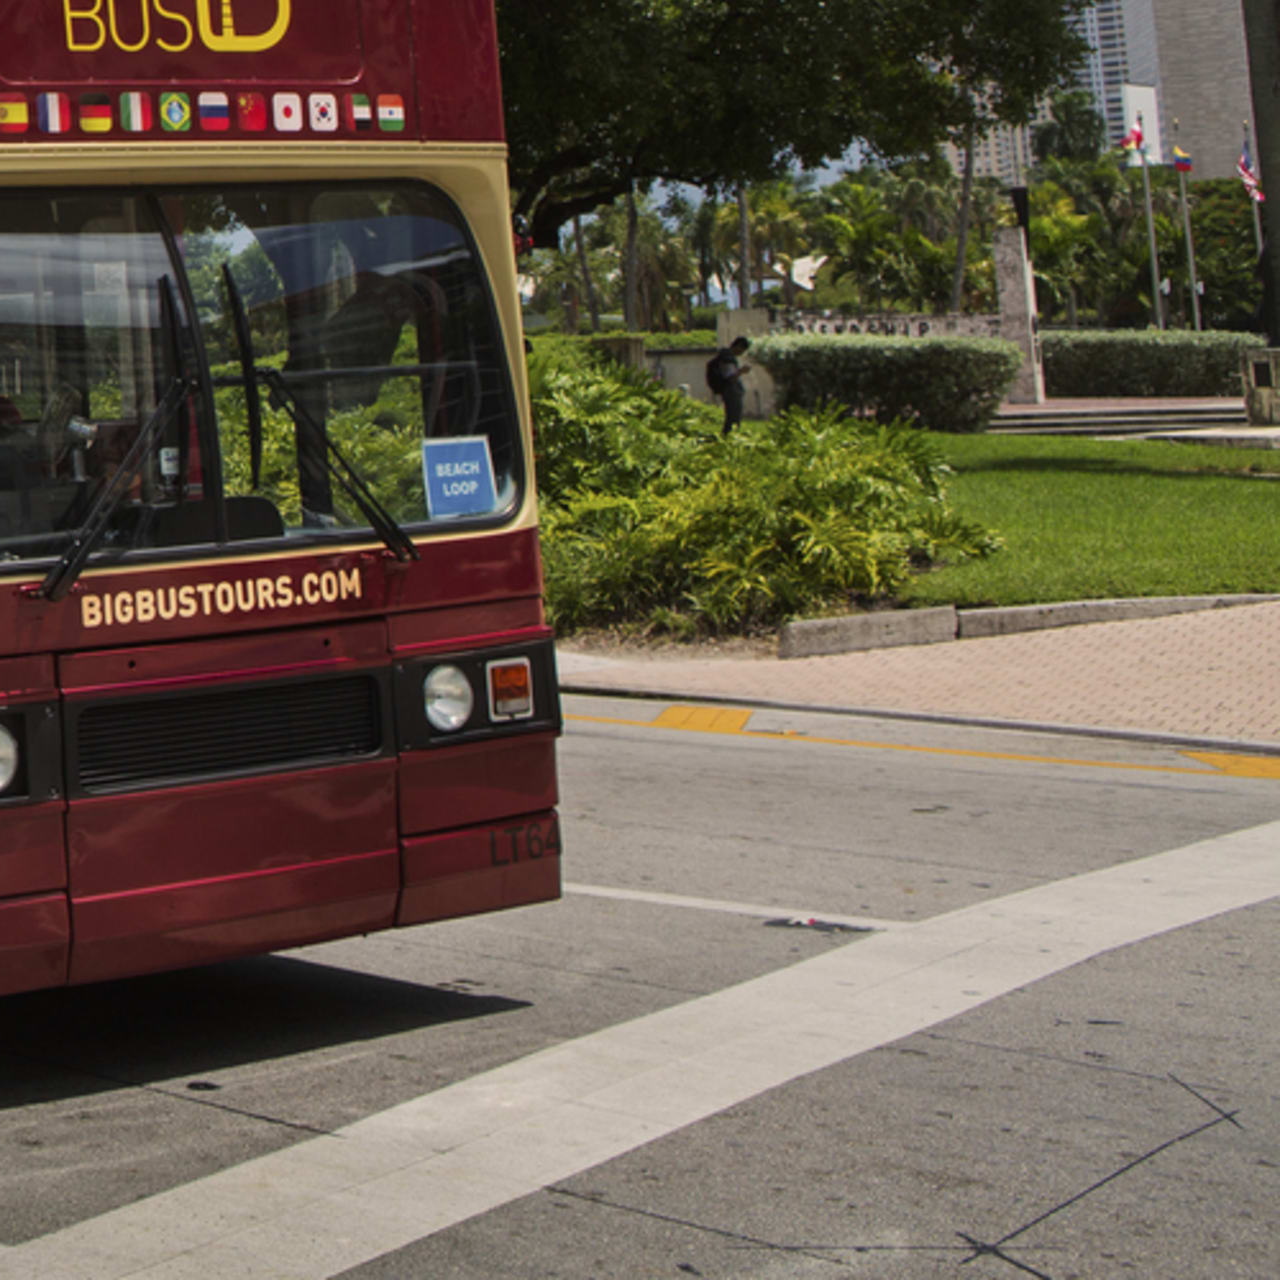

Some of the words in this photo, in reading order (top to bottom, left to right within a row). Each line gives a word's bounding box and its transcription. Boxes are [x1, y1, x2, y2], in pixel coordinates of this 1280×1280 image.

[435, 461, 479, 477] BEACH
[442, 481, 478, 497] LOOP
[81, 568, 362, 628] BIGBUSTOURS.COM
[489, 820, 562, 866] LT64
